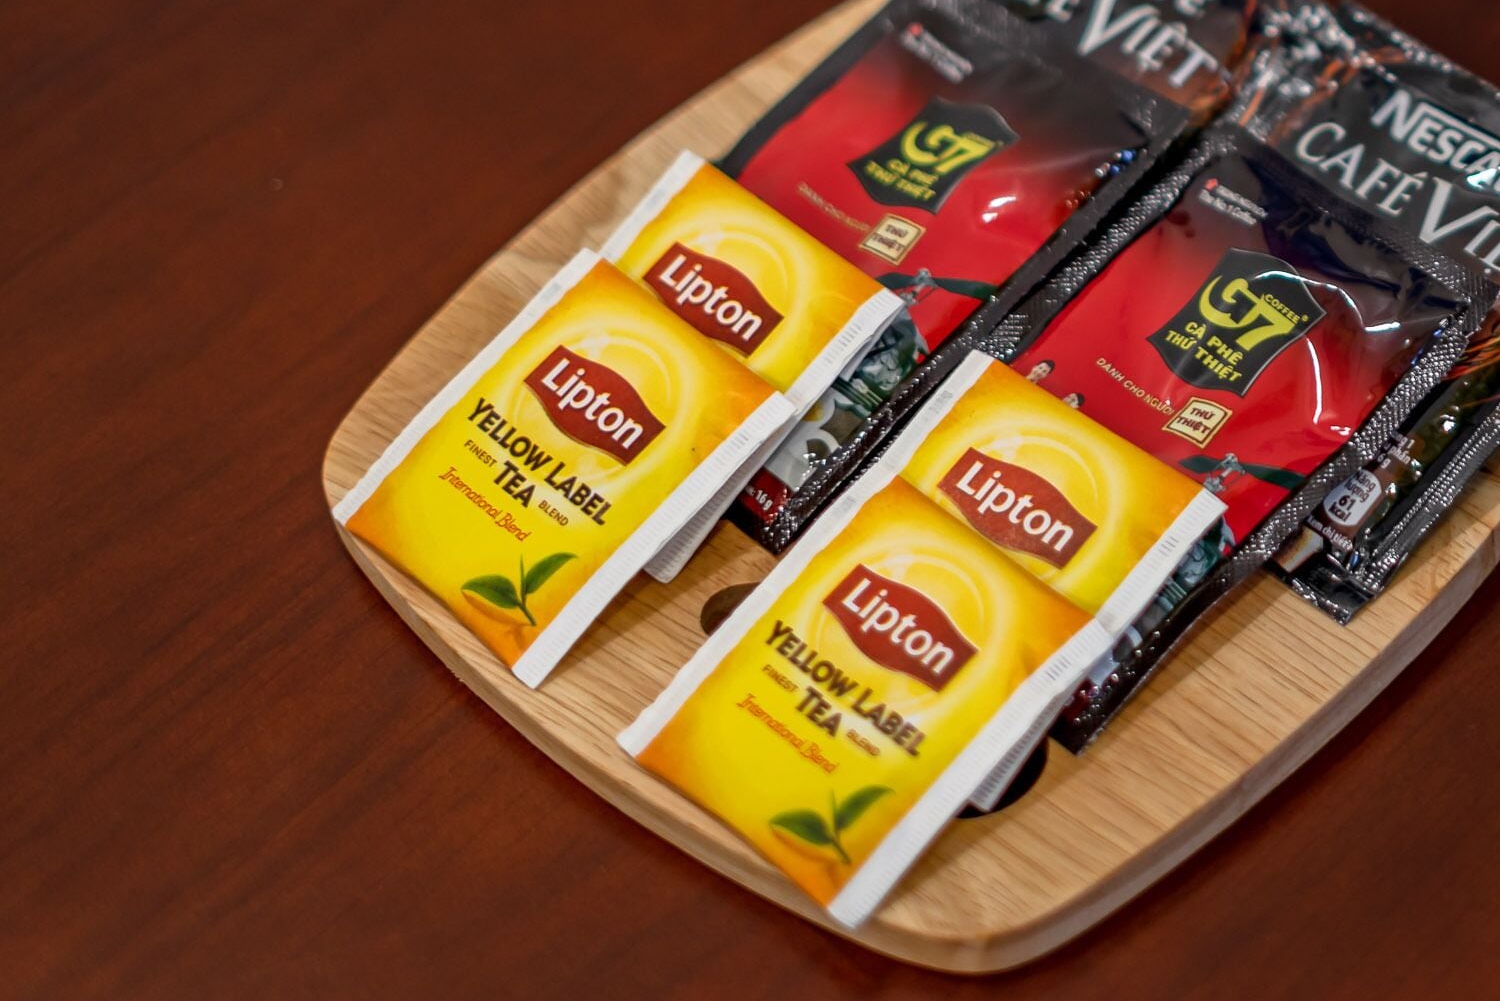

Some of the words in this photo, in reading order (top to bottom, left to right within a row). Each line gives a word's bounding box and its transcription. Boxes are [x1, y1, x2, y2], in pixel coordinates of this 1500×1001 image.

[1296, 121, 1429, 216] CAFÉ
[659, 254, 764, 342] Lipton
[1200, 275, 1297, 352] G7
[1264, 293, 1300, 324] COFFEE
[1165, 329, 1197, 350] THỨ
[1195, 346, 1242, 381] THIỆT
[1185, 321, 1206, 339] CÀ
[1208, 336, 1244, 366] PHÊ
[540, 357, 644, 450] Lipton
[1123, 380, 1145, 398] CHO
[463, 439, 498, 468] FINEST
[493, 460, 536, 508] TEA
[538, 500, 569, 527] BLEND
[467, 397, 553, 472] YELLOW
[543, 461, 612, 526] LABEL
[438, 466, 504, 520] International
[494, 511, 533, 542] Blend
[955, 460, 1075, 552] Lipton
[1329, 502, 1352, 522] kcal
[1338, 494, 1356, 511] 61
[841, 578, 955, 674] Lipton
[762, 664, 799, 693] FINEST
[795, 686, 843, 737] TEA
[765, 619, 859, 697] YELLOW
[851, 688, 926, 757] LABEL
